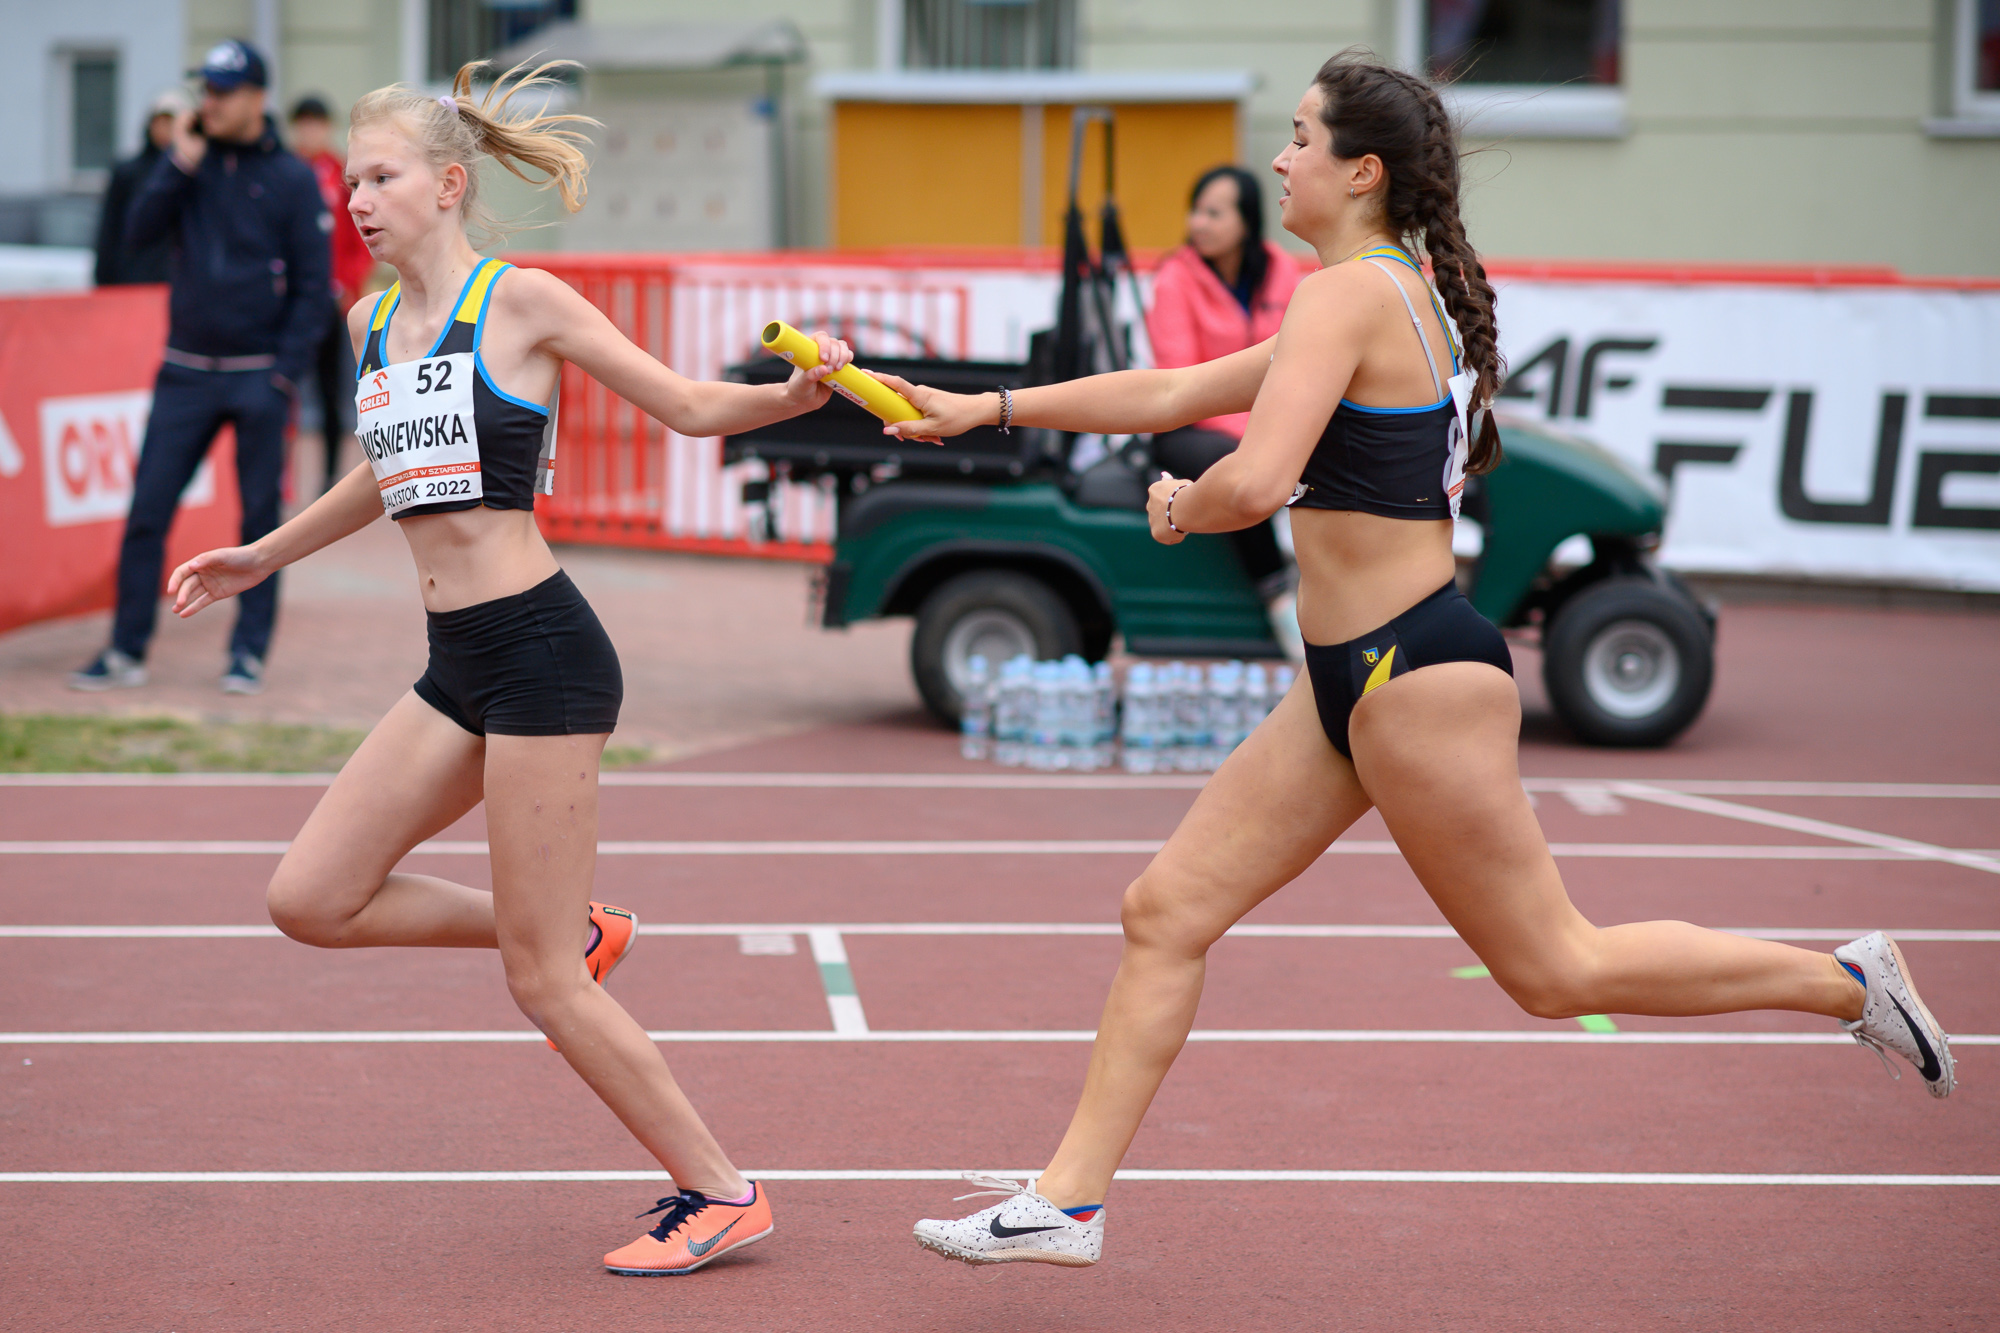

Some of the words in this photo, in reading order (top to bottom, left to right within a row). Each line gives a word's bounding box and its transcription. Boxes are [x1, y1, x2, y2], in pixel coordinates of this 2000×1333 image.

[415, 360, 453, 395] 52
[360, 392, 389, 412] ORLEN
[358, 413, 469, 463] WIŚNIEWSKA
[428, 464, 476, 475] SZTAFETACH
[426, 480, 471, 498] 2022
